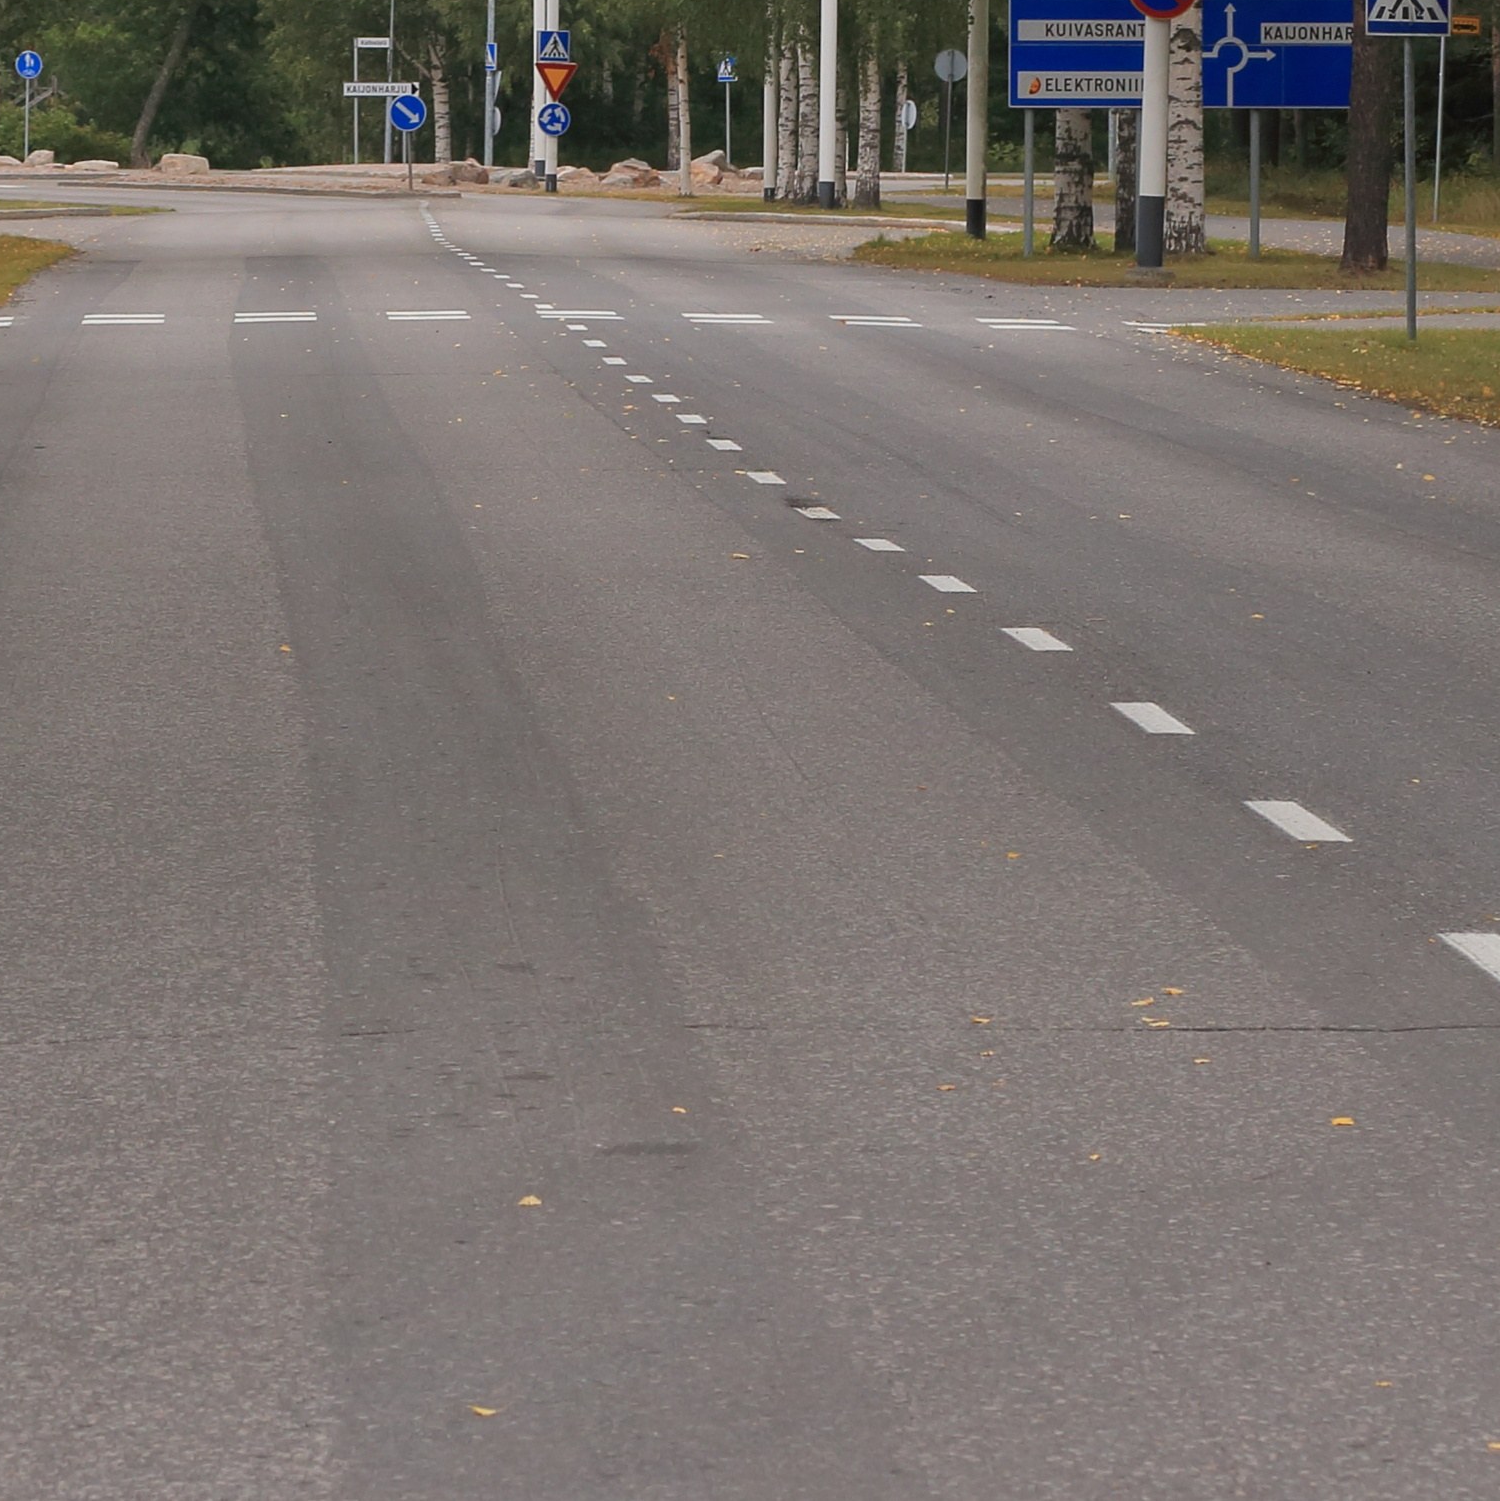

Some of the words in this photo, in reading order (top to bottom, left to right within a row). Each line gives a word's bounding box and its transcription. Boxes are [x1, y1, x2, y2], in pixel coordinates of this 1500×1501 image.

[1045, 23, 1145, 37] KUIVASRANT
[1264, 26, 1354, 40] KAIJONHAR
[346, 84, 408, 94] KAIJONHARJU
[1045, 78, 1144, 92] ELEKTRONII
